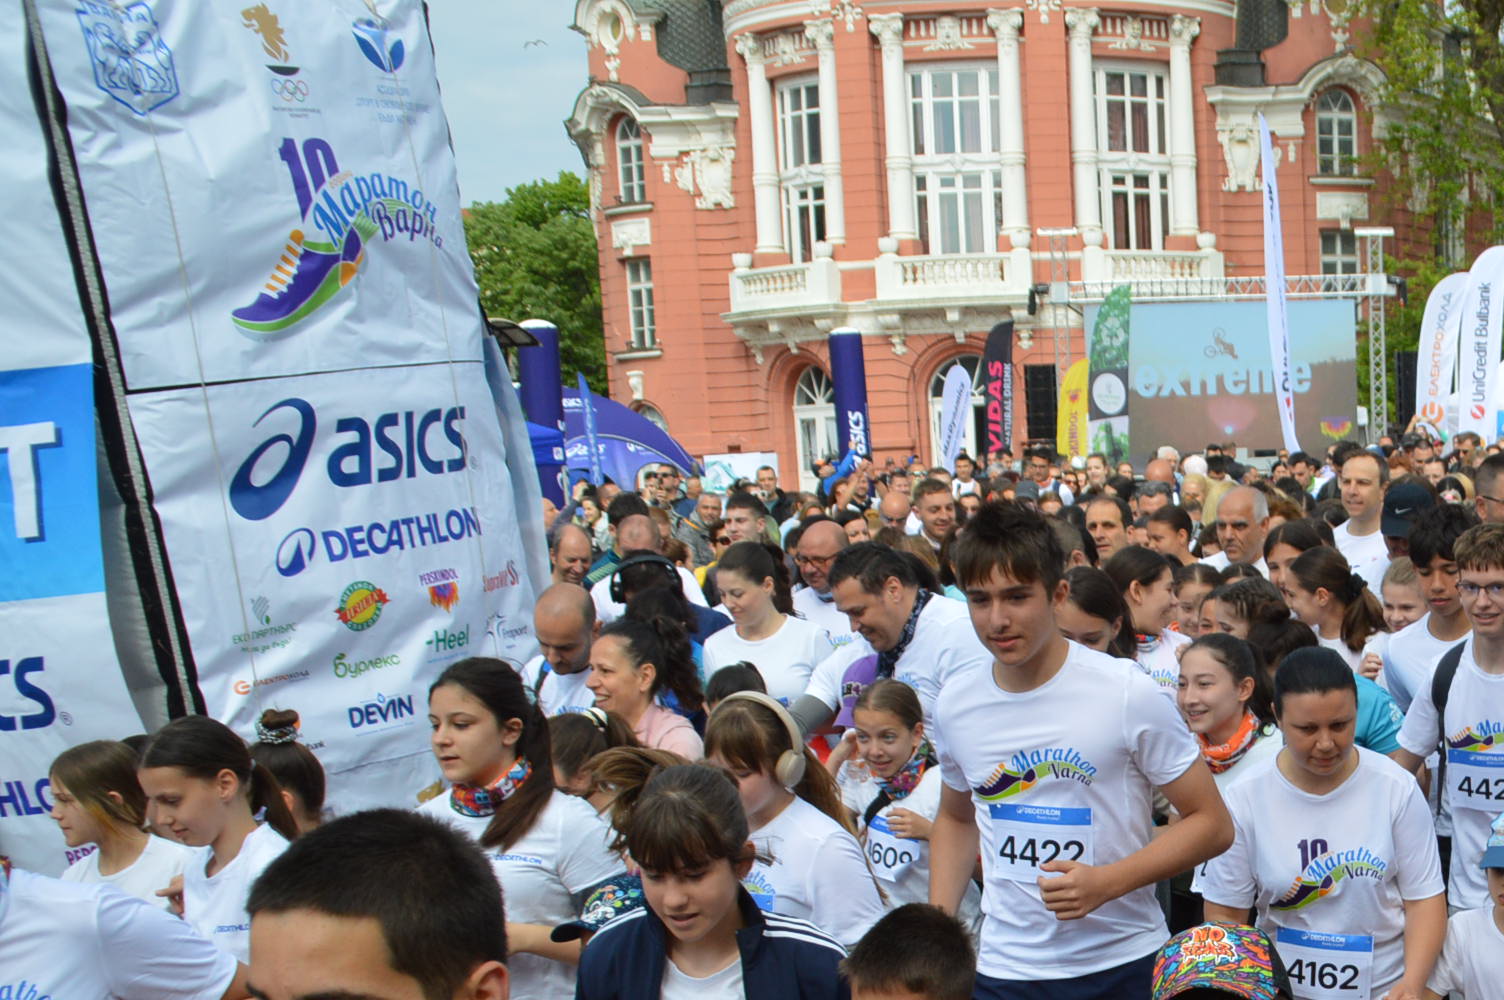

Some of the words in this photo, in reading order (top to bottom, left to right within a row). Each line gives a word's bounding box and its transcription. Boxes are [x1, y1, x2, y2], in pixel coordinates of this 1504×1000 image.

[313, 172, 437, 248] Маратон
[371, 200, 443, 249] Варна
[1476, 281, 1491, 337] Bulbank
[1473, 340, 1488, 402] UniCredit
[987, 360, 1004, 453] VIDAS
[323, 507, 483, 563] DECATHLON
[348, 694, 415, 729] DEVIN
[1012, 747, 1098, 777] Marathon
[1047, 761, 1093, 788] Varna
[999, 835, 1085, 868] 4422
[1308, 847, 1387, 883] Marathon
[1341, 863, 1385, 881] Varna
[1287, 959, 1360, 990] 4162
